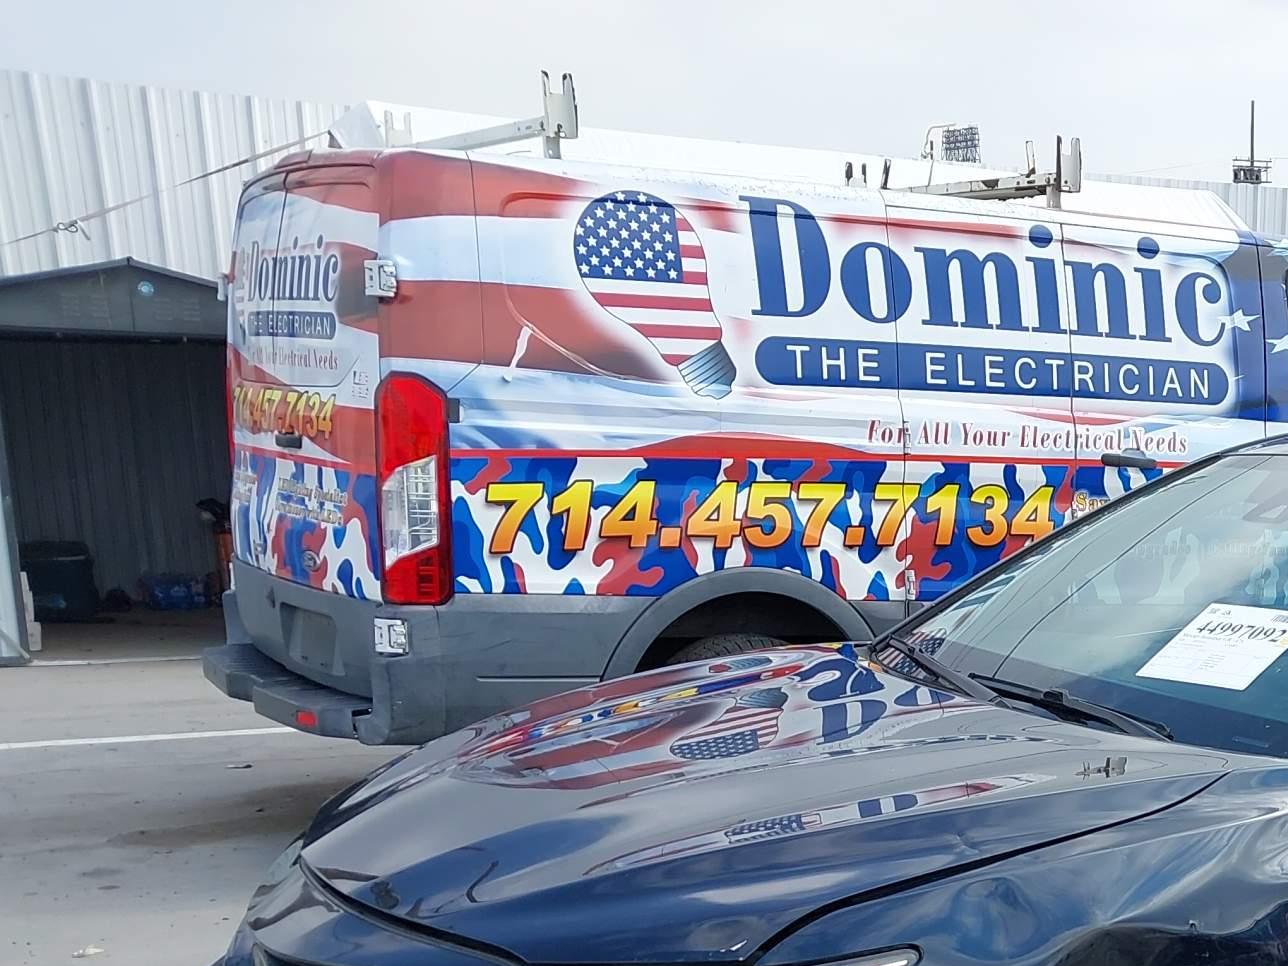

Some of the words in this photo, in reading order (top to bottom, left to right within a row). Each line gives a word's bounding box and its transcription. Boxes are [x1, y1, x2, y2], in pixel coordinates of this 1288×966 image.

[247, 234, 339, 302] Dominic
[739, 195, 1227, 347] Dominic
[268, 314, 331, 335] ELECTRICIAN
[313, 348, 338, 371] Needs
[786, 344, 881, 383] THE
[925, 352, 1211, 399] ELECTRICIAN
[866, 419, 909, 444] For
[917, 420, 949, 445] All
[960, 422, 1011, 447] Your
[1020, 424, 1123, 451] Electrical
[1129, 427, 1188, 453] Needs
[484, 480, 1056, 554] 714.457.7134
[1195, 620, 1288, 643] 44997092
